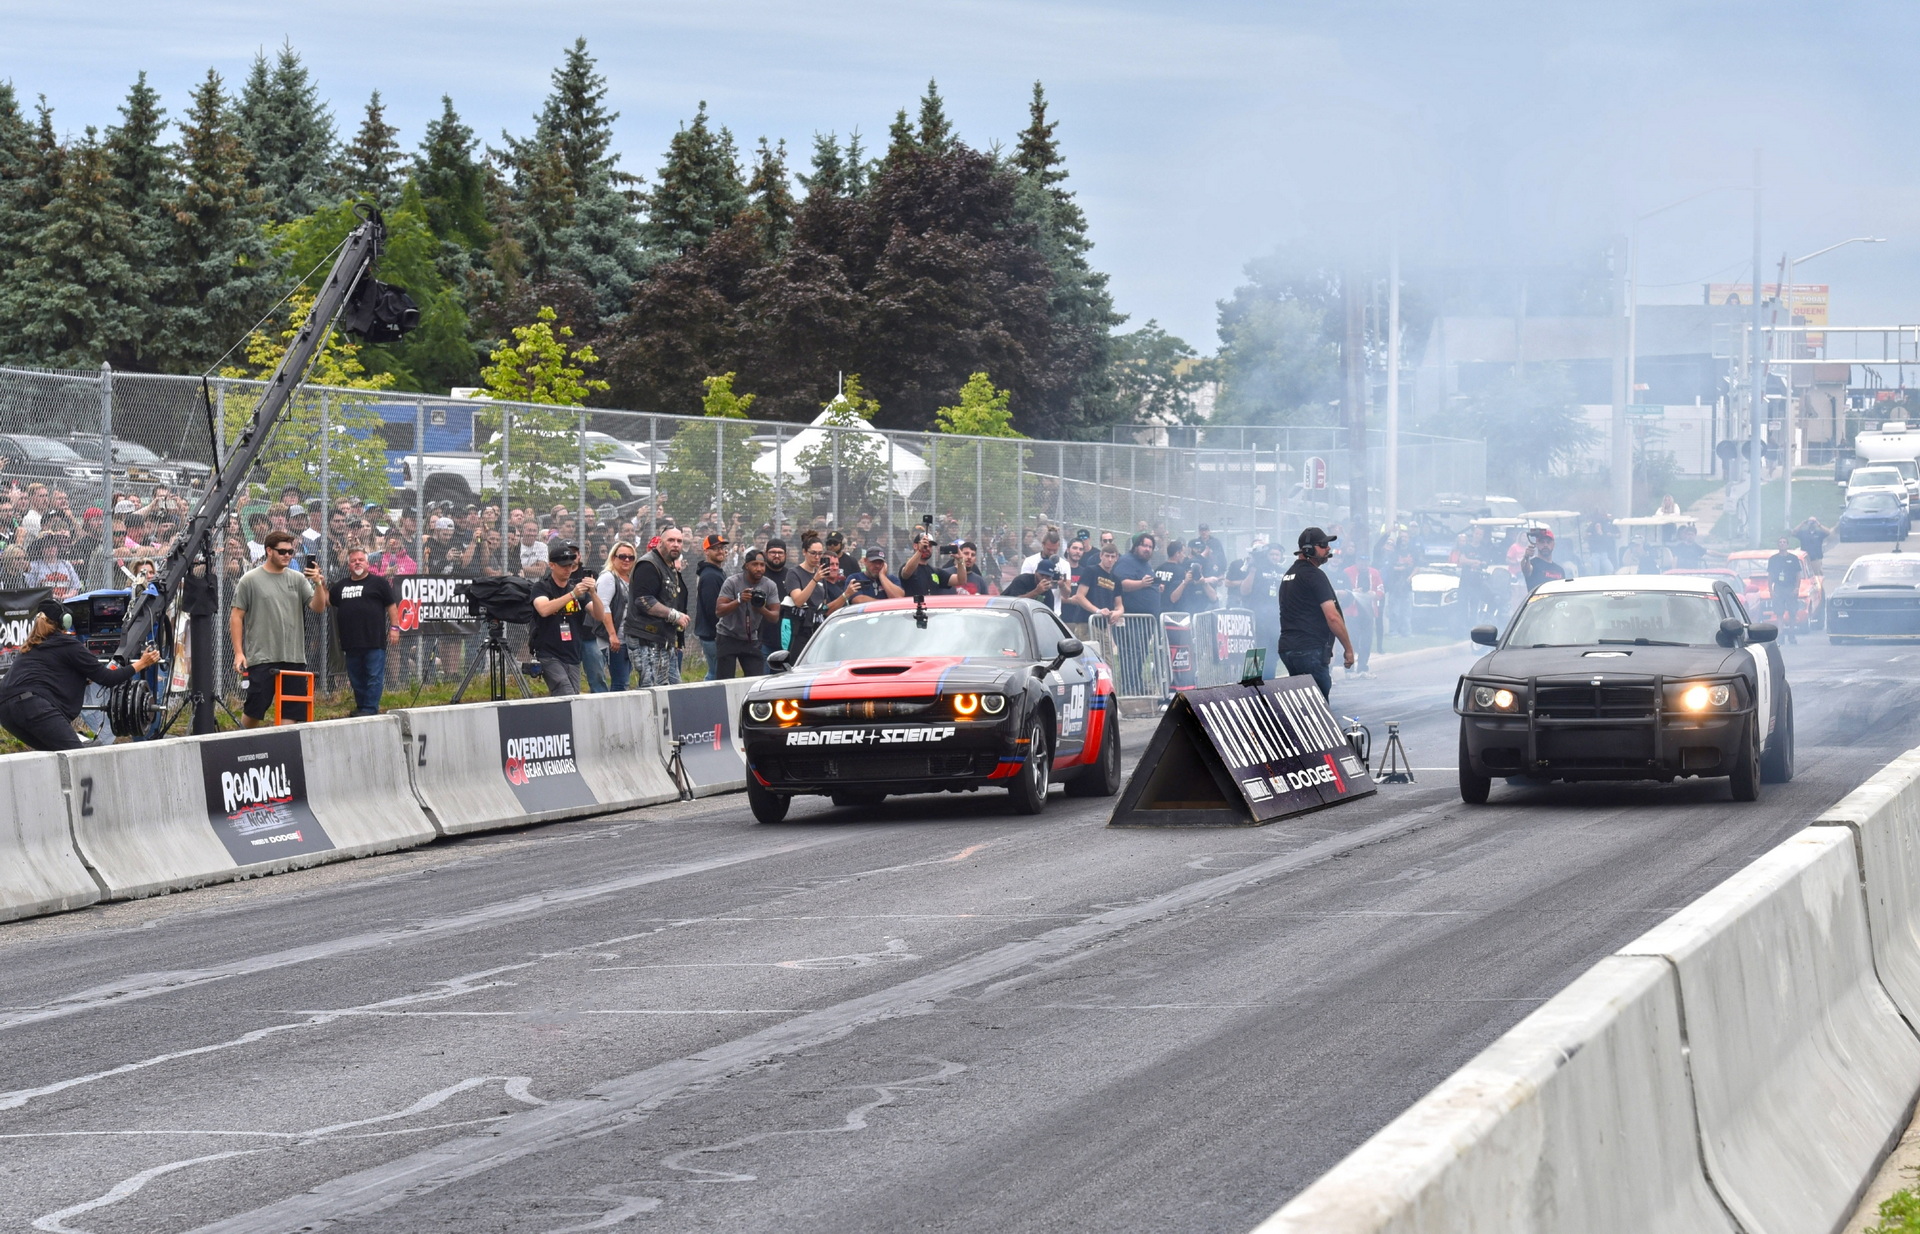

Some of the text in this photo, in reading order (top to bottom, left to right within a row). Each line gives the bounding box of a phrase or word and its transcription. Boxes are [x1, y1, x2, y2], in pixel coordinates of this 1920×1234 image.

[1793, 307, 1825, 315] QUEEN!
[401, 578, 473, 603] OVERDR
[418, 605, 440, 623] GEAR
[786, 730, 865, 746] REDNECK
[1199, 686, 1347, 769] ROADKILL NIGHTS
[507, 734, 572, 760] OVERDRIVE
[523, 758, 577, 778] GEAR VENDORS
[1287, 764, 1338, 790] DODGE
[221, 763, 291, 813] ROADKILL
[268, 832, 299, 844] DODGE
